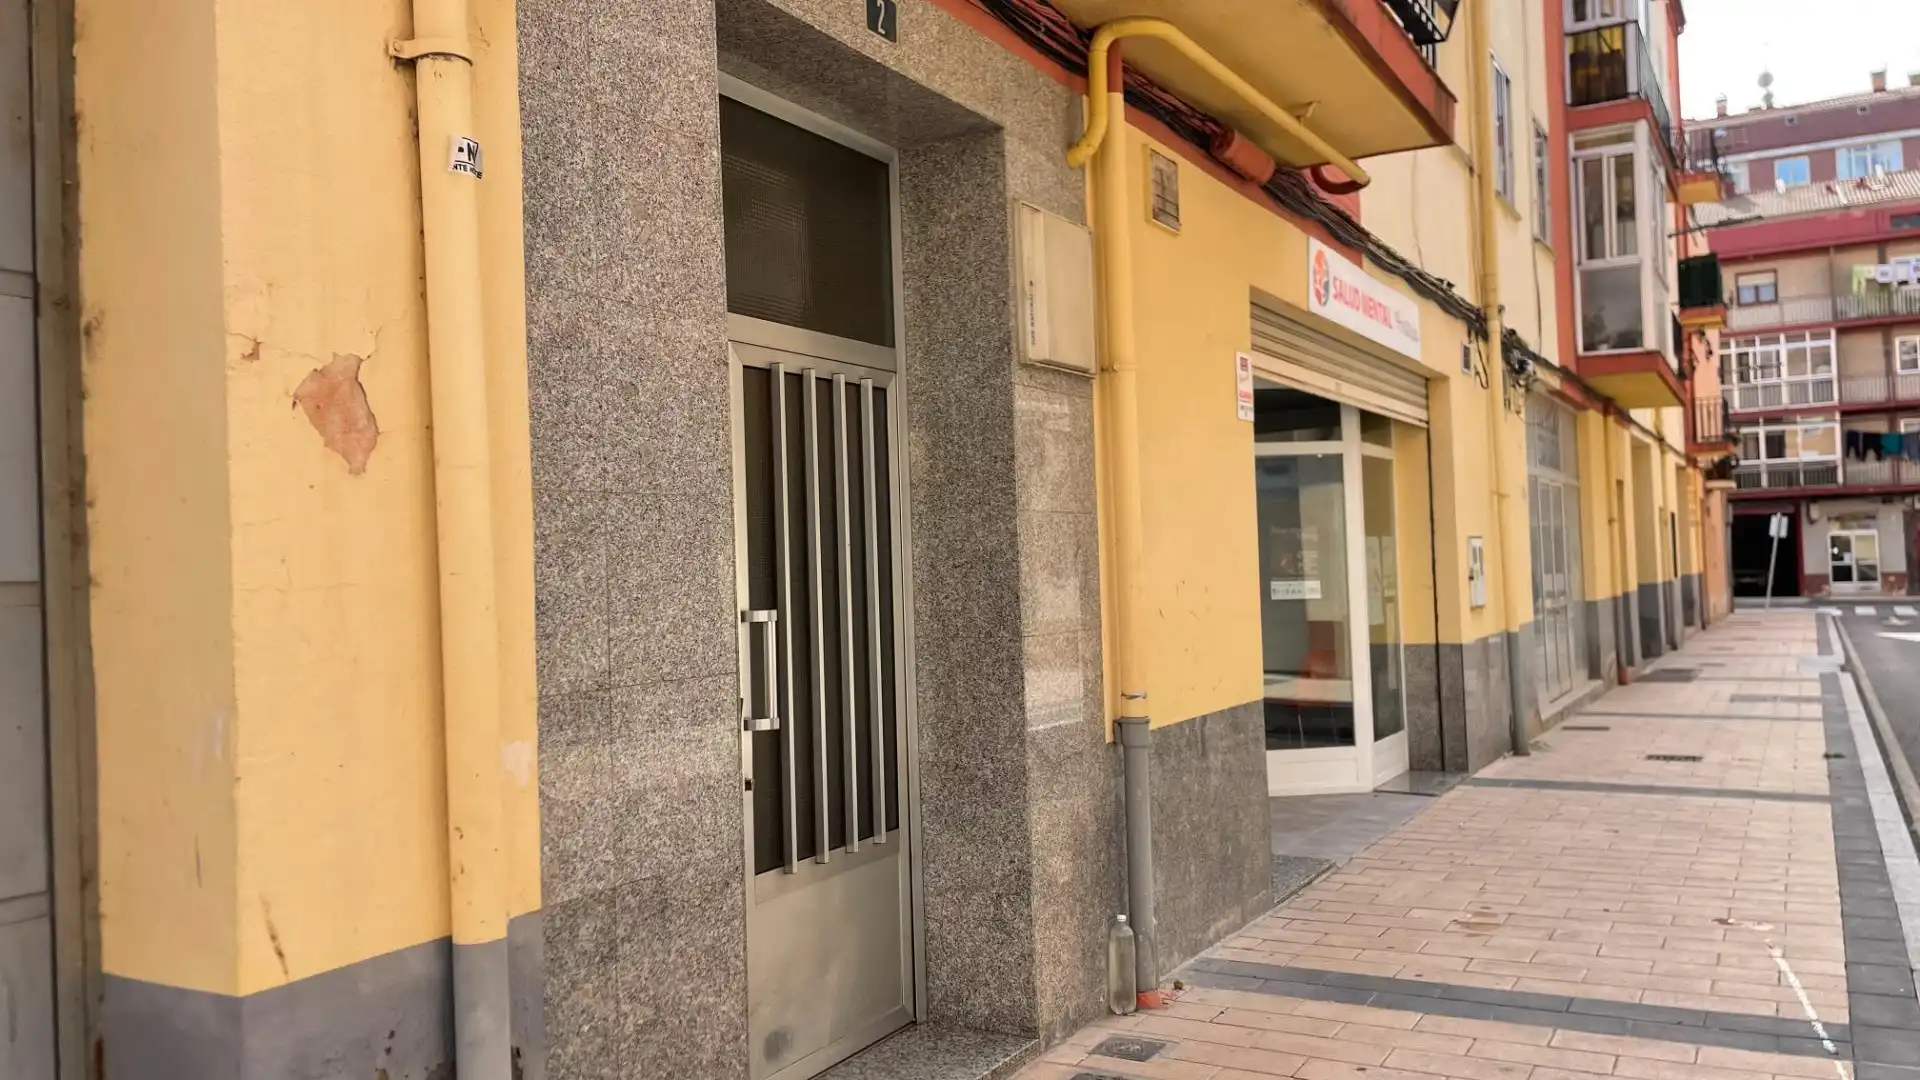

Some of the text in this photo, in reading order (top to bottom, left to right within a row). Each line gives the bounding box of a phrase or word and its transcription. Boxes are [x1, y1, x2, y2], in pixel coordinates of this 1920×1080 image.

[877, 0, 886, 35] 2
[1332, 276, 1360, 312] SALUD
[1361, 291, 1394, 330] MENTAL
